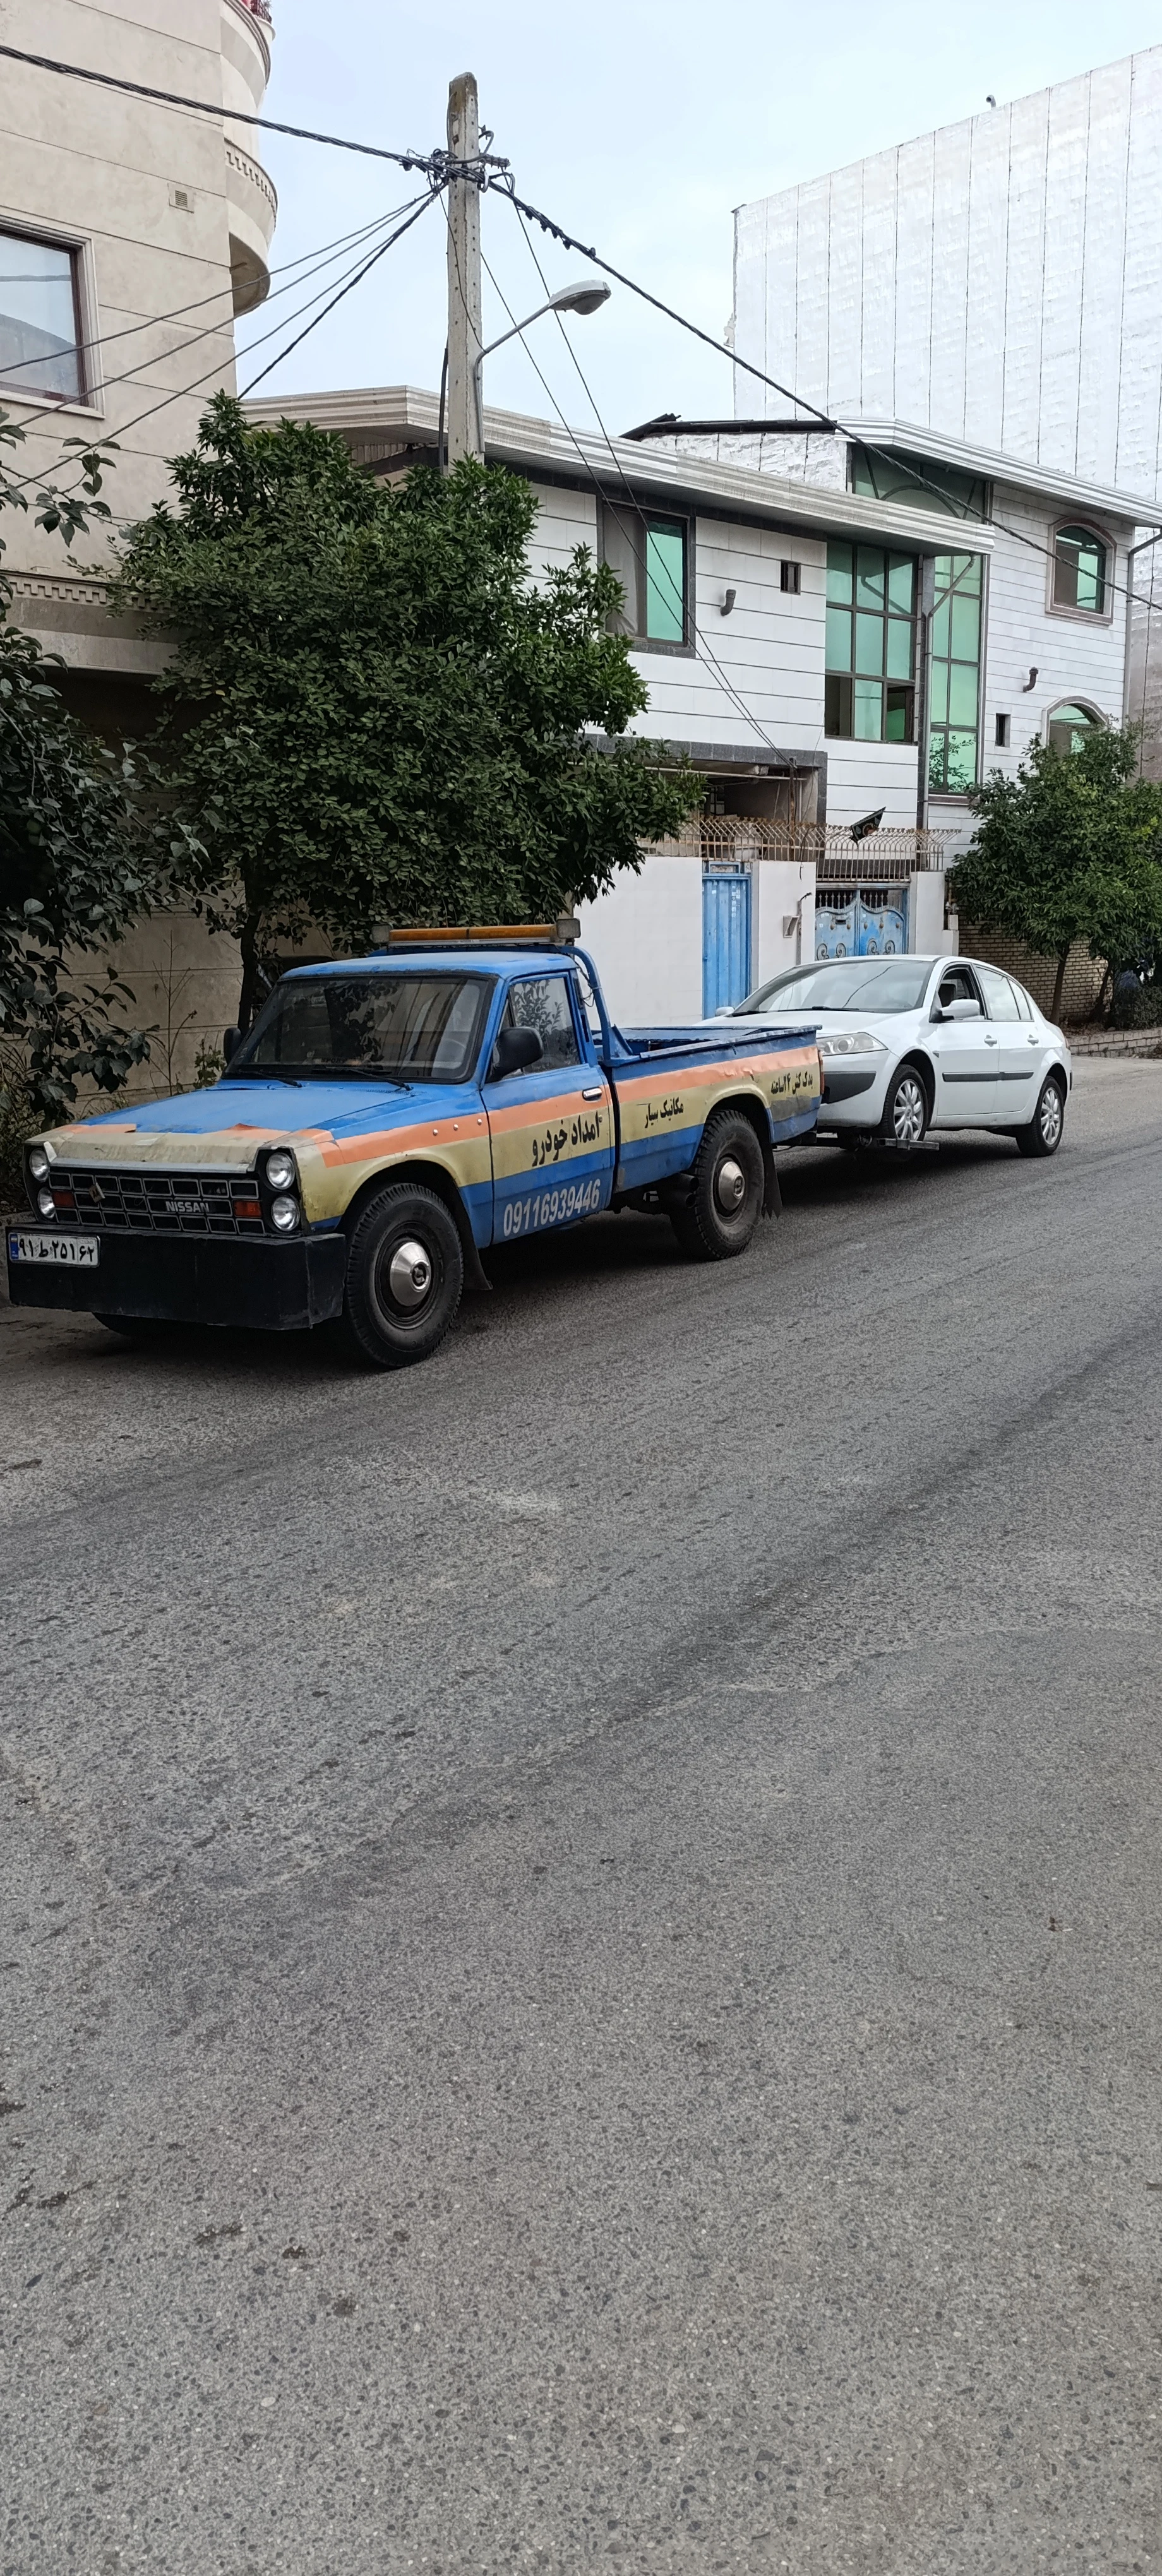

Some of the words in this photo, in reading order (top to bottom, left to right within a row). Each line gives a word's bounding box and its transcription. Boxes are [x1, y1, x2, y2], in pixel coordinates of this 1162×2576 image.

[792, 1071, 801, 1095] کش
[644, 1102, 659, 1129] سیار
[660, 1096, 684, 1121] مکانیک
[571, 1109, 600, 1146] امداد
[532, 1118, 568, 1167] خودرو
[165, 1201, 210, 1213] NISSAN
[503, 1178, 601, 1237] 09116939446
